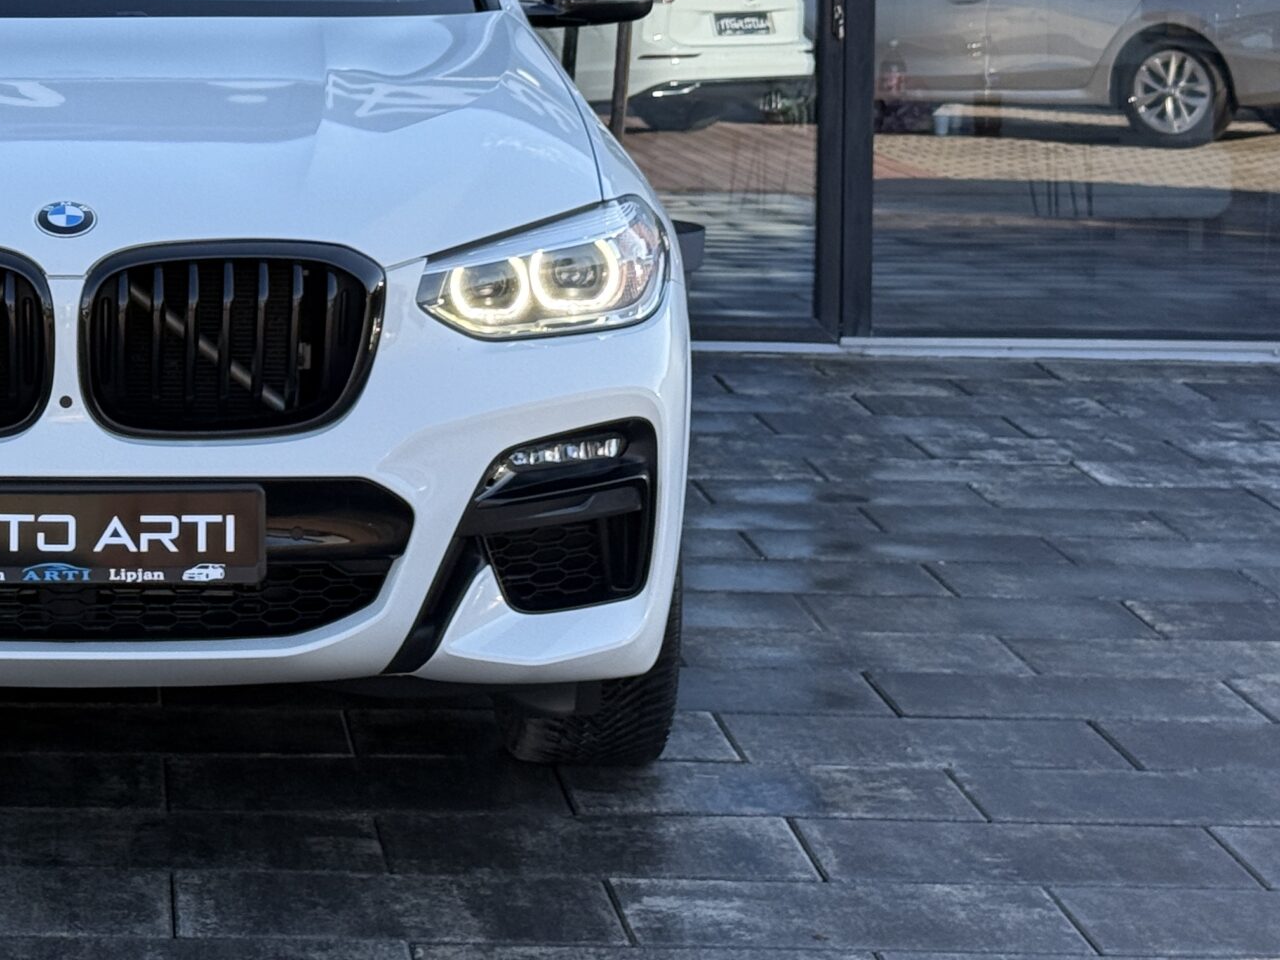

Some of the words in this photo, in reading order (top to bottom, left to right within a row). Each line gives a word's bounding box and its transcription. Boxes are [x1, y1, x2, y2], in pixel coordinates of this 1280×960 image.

[93, 514, 236, 553] ARTI
[22, 569, 91, 581] ARTI
[109, 568, 165, 583] Lipjan
